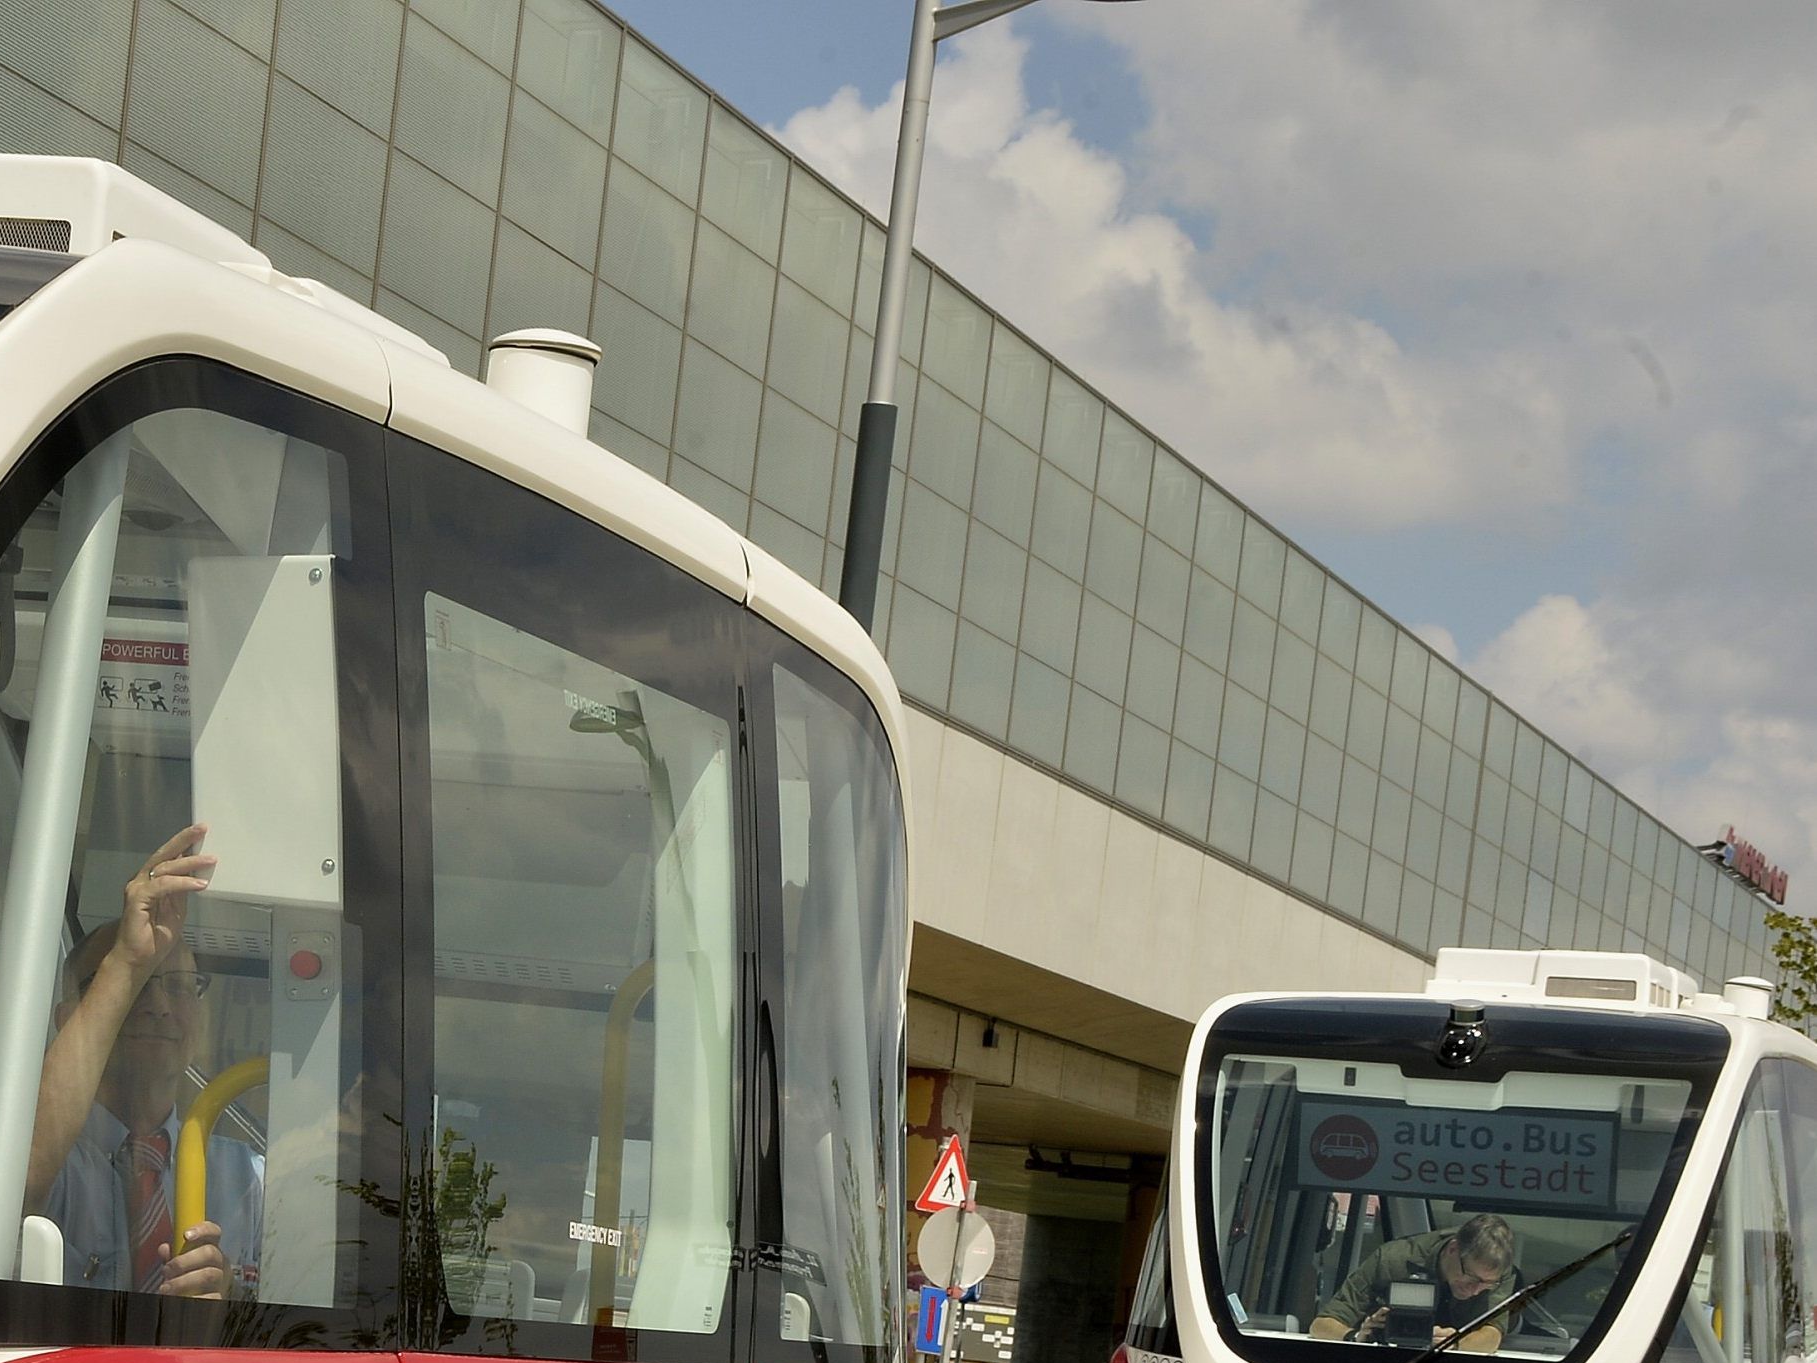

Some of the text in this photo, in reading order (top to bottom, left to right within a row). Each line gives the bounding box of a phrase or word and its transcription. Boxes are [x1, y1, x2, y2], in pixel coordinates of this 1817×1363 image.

[102, 643, 179, 660] POWERFUL
[1393, 1117, 1597, 1157] auto.Bus
[1390, 1152, 1595, 1194] Seestadt
[569, 1221, 622, 1246] EMERGENCY EXIT
